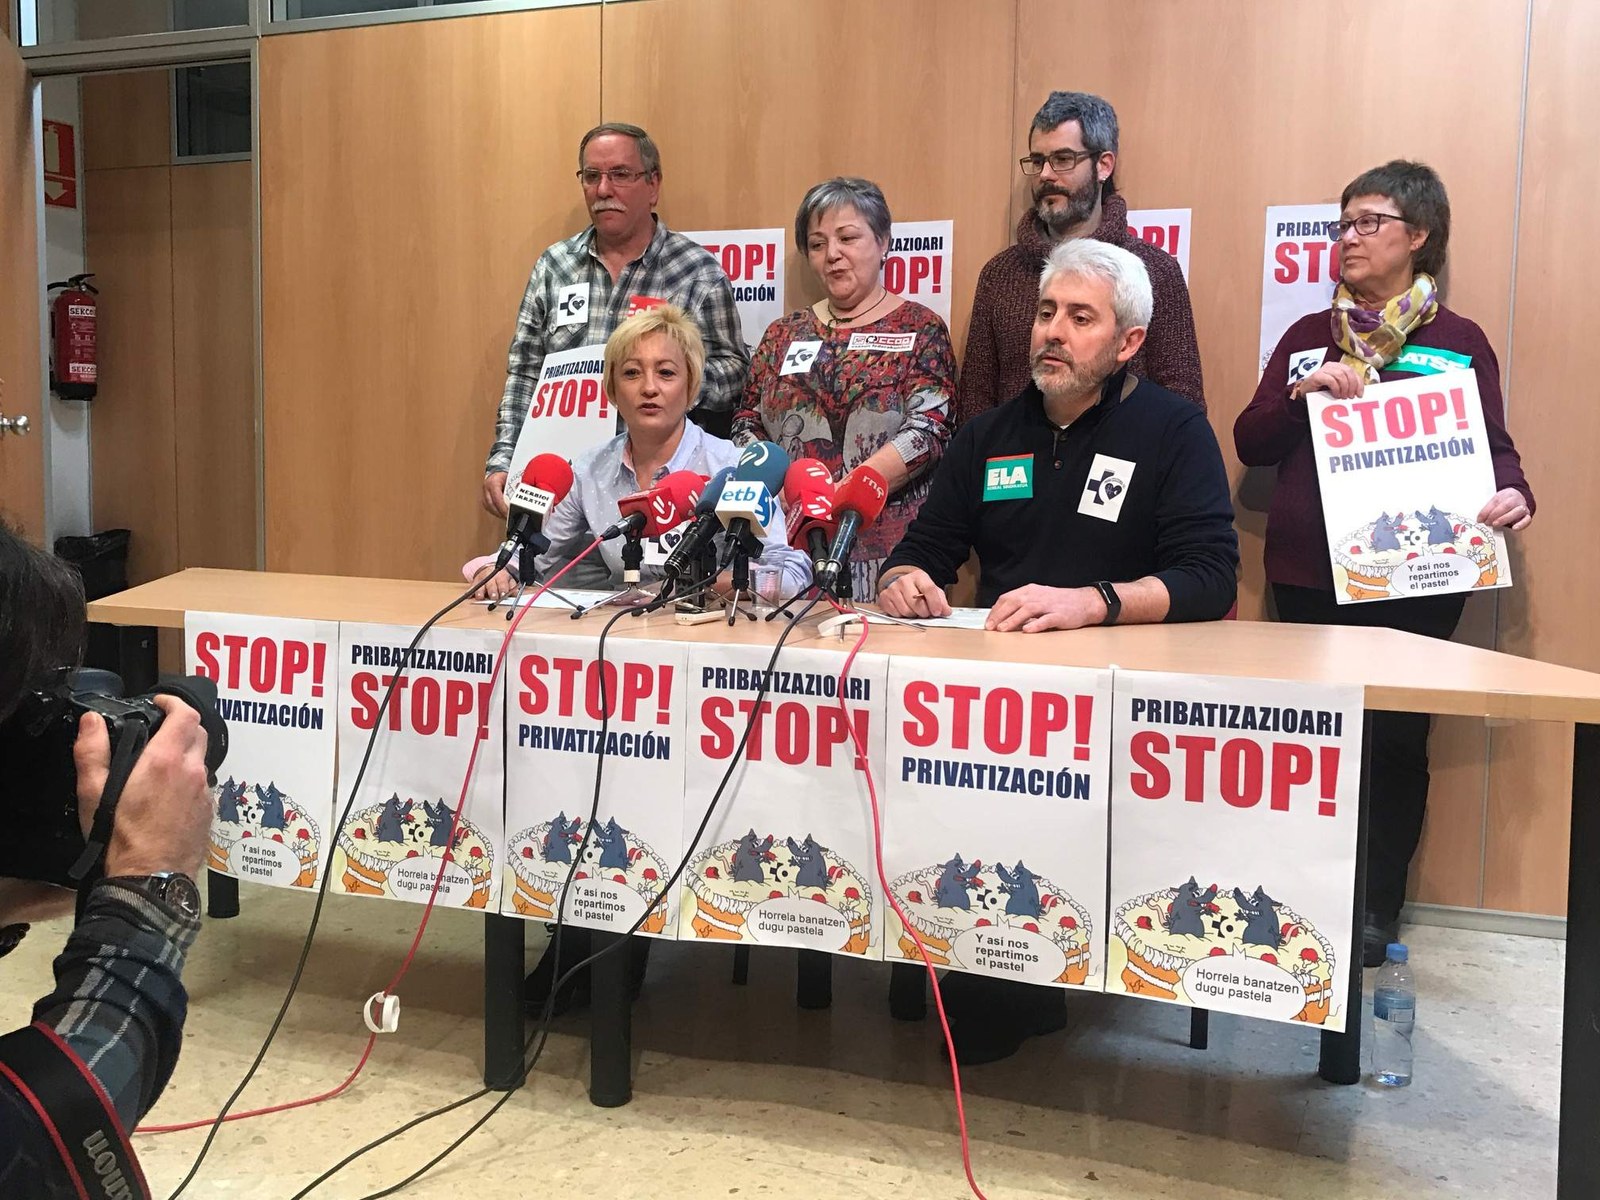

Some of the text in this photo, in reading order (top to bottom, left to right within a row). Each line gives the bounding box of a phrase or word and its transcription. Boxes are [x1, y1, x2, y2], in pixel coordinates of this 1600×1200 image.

[884, 256, 943, 294] OP!
[544, 360, 604, 380] PRIBATIZAZIOA
[532, 379, 608, 418] STOP!
[1321, 388, 1469, 448] STOP!
[1329, 437, 1475, 474] PRIVATIZACIÓN
[988, 466, 1028, 486] ELA
[722, 486, 756, 502] etb
[1408, 564, 1414, 572] Y
[1434, 562, 1450, 570] nos
[1409, 570, 1459, 581] repartimos
[1410, 579, 1449, 590] el pastel
[195, 632, 327, 698] STOP!
[351, 644, 494, 674] PRIBATIZAZIOARI
[518, 654, 674, 725] STOP!
[702, 666, 870, 701] PRIBATIZAZIOARI
[350, 672, 493, 740] STOP!
[902, 680, 1094, 762] STOP!
[1131, 698, 1343, 737] PRIBATIZAZIOARI
[518, 724, 670, 760] PRIVATIZACIÓN
[700, 696, 870, 771] STOP!
[901, 756, 1090, 800] PRIVATIZACIÓN
[1129, 730, 1341, 817] STOP!
[242, 844, 247, 852] Y
[262, 849, 276, 857] nos
[242, 856, 282, 868] repartimos
[242, 864, 272, 876] el pastel
[398, 868, 428, 880] Horrela
[397, 879, 450, 894] dugu pasela
[575, 886, 581, 894] Y
[600, 891, 618, 900] nos
[574, 898, 626, 912] repartimos
[574, 908, 614, 922] el pastel
[758, 922, 824, 936] dugu pastela
[759, 910, 846, 928] Horrela banatzen
[976, 933, 983, 943] Y
[1008, 940, 1029, 950] nos
[976, 946, 1039, 962] repartimos
[976, 957, 1024, 972] el pastel
[1196, 968, 1300, 994] Horrela banatzen
[1195, 982, 1272, 1003] dugu pastela
